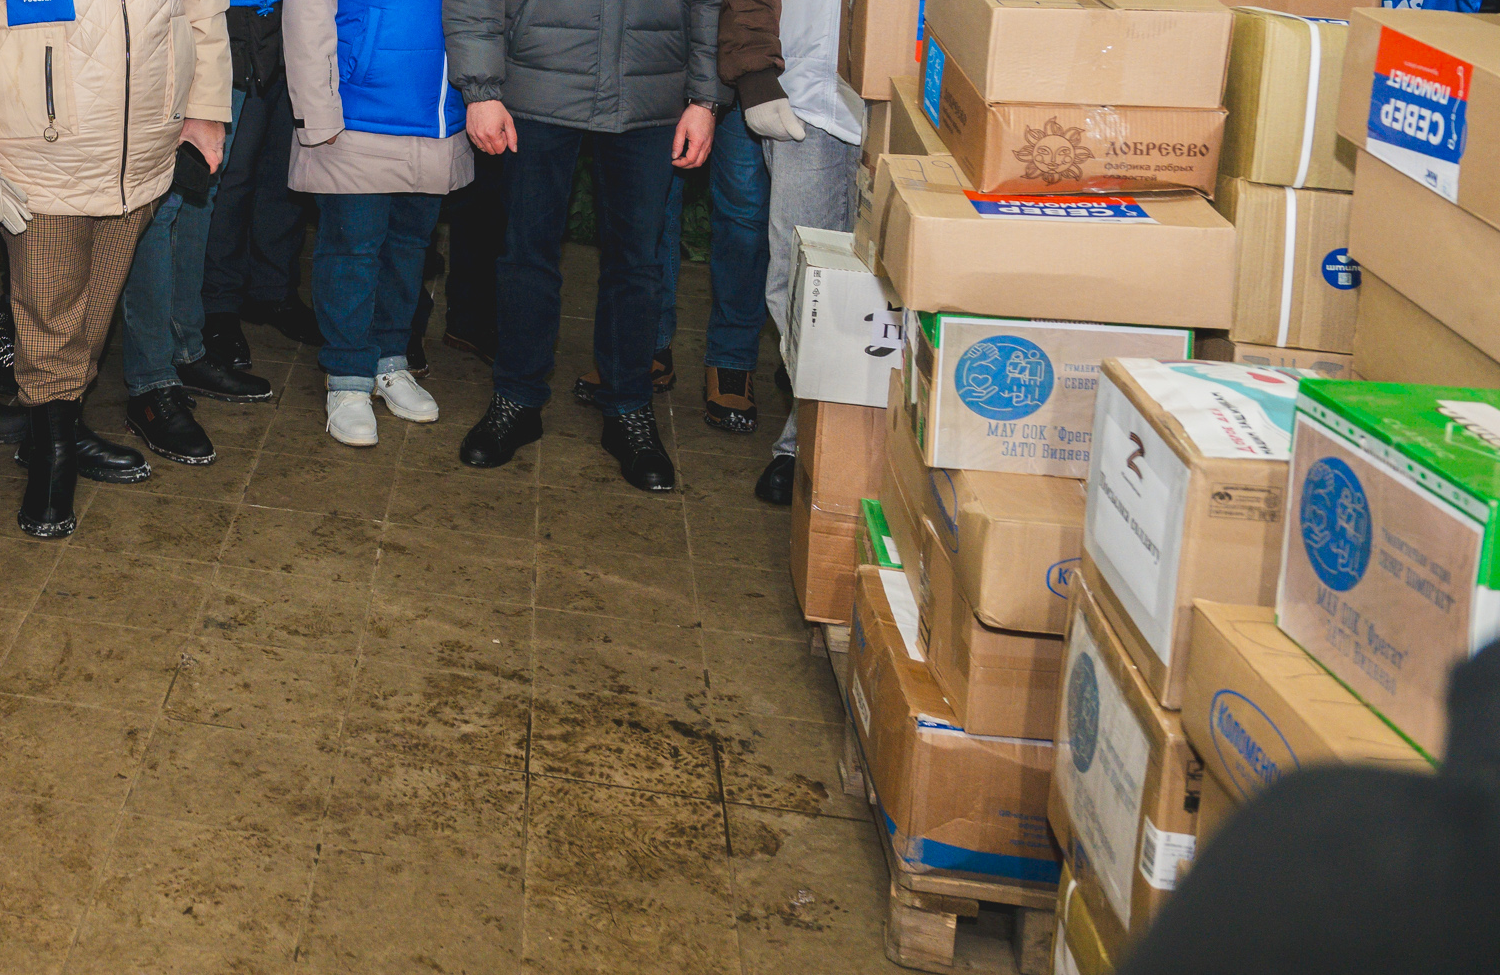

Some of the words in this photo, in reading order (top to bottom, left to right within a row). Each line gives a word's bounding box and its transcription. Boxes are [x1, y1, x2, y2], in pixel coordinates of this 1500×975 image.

[1386, 69, 1450, 105] ПОМОГАЕТ
[1380, 98, 1445, 145] СЕВЕР
[1104, 163, 1151, 172] фабрика
[1153, 163, 1194, 173] добрых
[998, 206, 1115, 217] СЕВЕР
[1065, 378, 1097, 390] СЕВЕР
[987, 422, 1016, 437] МАУ
[1022, 425, 1047, 440] СОК
[1001, 441, 1036, 458] ЗАТО
[1042, 444, 1090, 463] Видяев
